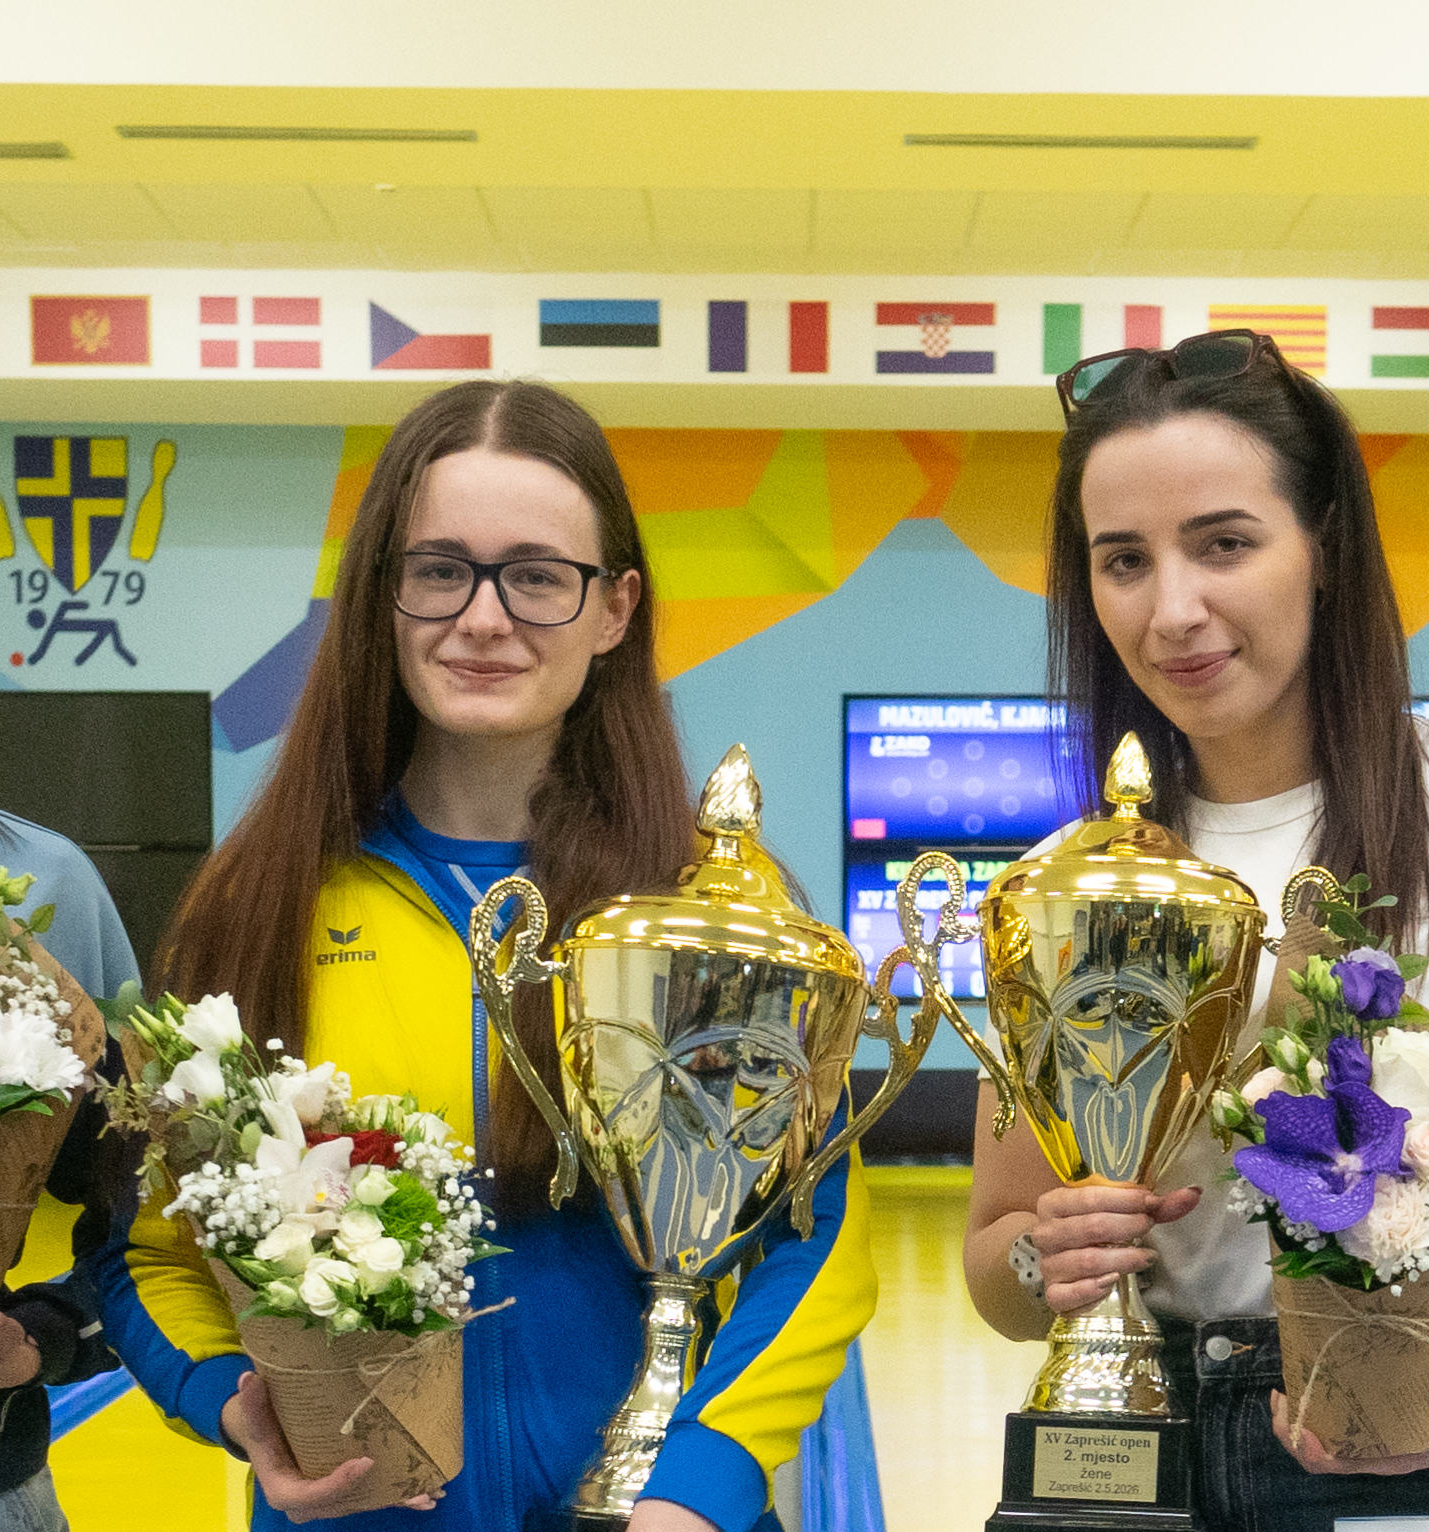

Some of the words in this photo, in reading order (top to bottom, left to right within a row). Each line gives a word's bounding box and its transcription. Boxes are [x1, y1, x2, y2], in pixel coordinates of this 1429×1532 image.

[9, 569, 50, 604] 19
[101, 570, 146, 605] 79
[316, 949, 376, 965] erima
[1044, 1432, 1063, 1444] XV
[1064, 1433, 1118, 1448] Zaprešić
[1120, 1437, 1151, 1450] open
[1064, 1449, 1076, 1461] 2.
[1081, 1452, 1131, 1465] mjesto
[1080, 1467, 1112, 1480] žene
